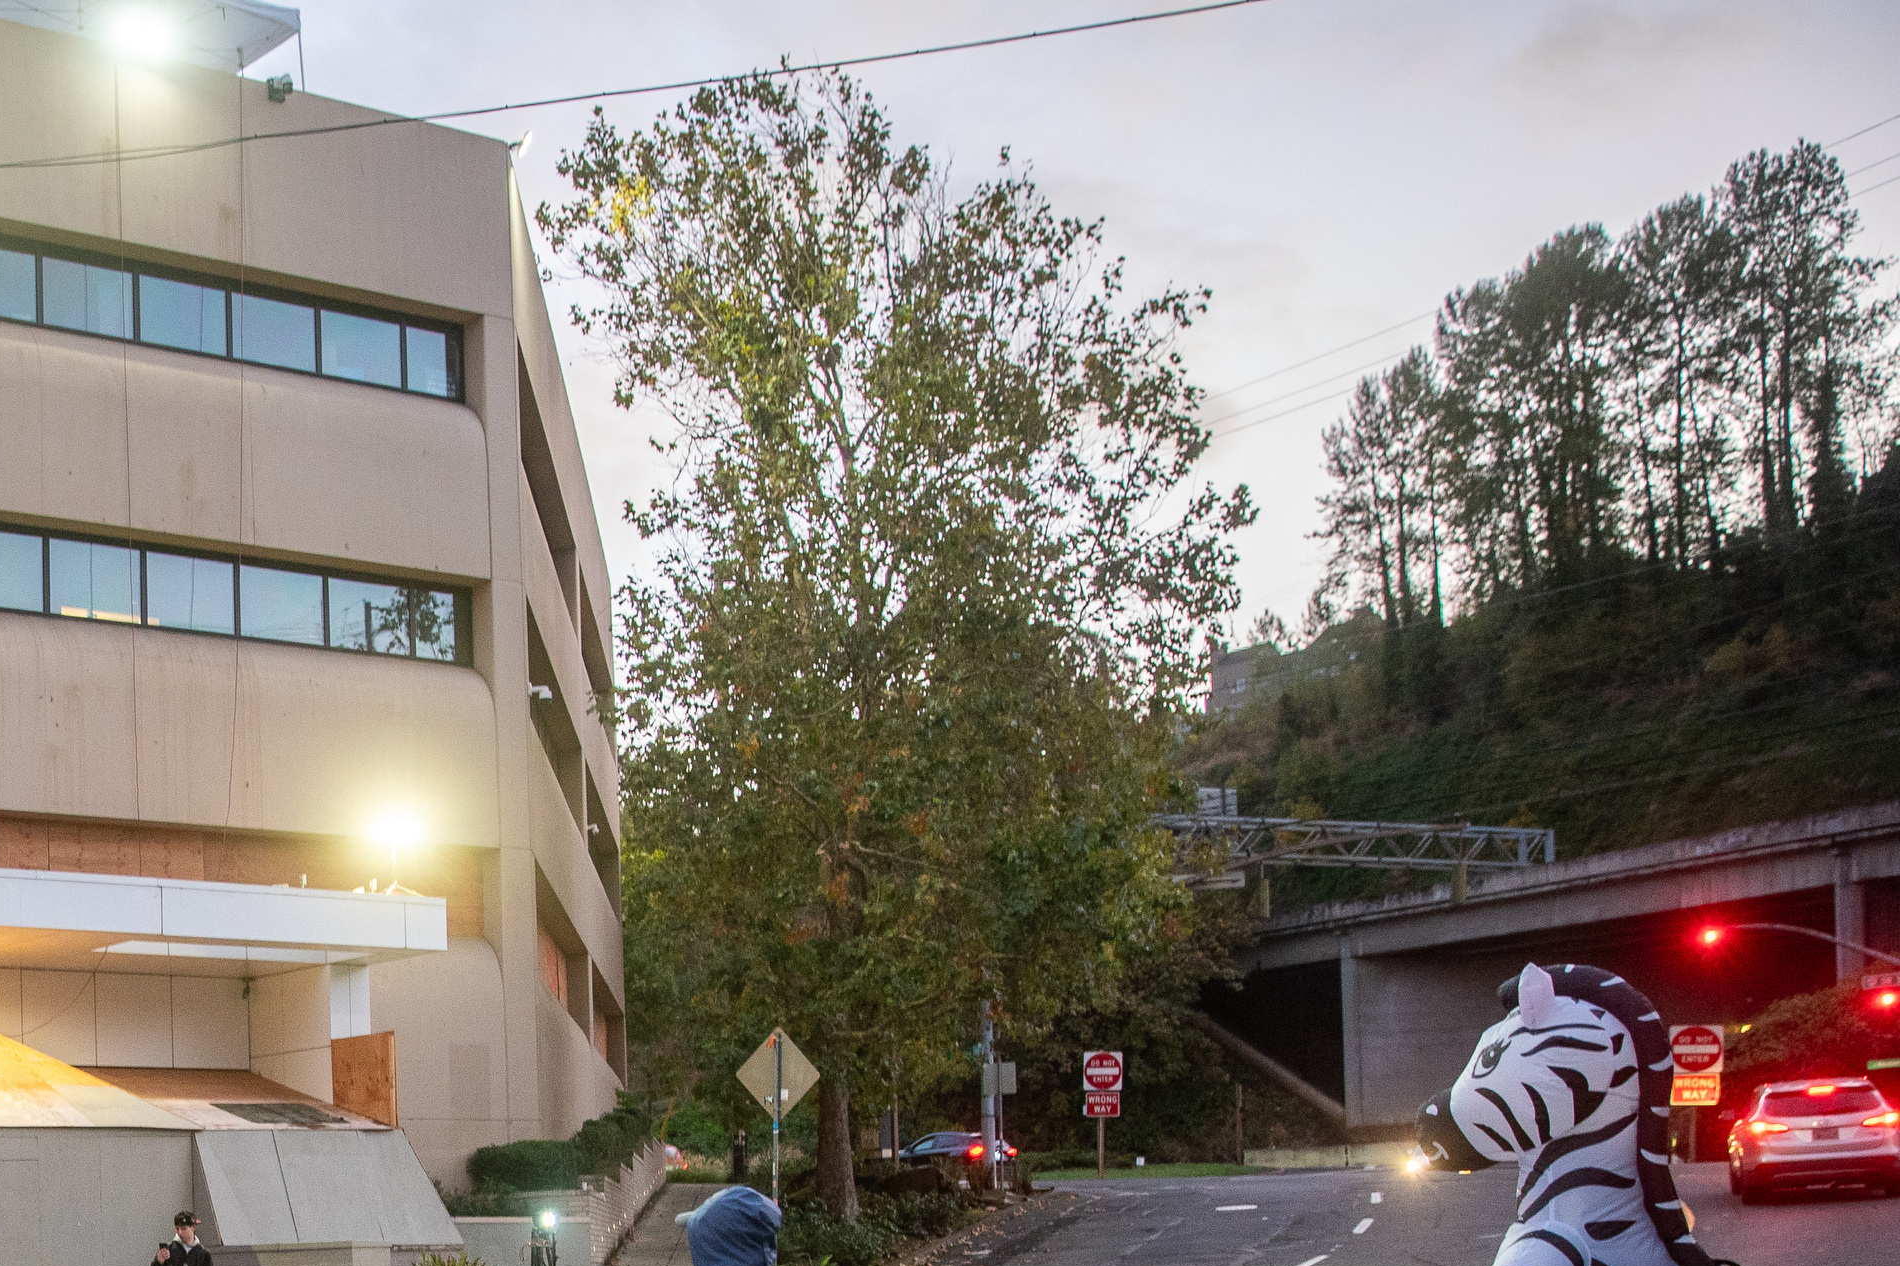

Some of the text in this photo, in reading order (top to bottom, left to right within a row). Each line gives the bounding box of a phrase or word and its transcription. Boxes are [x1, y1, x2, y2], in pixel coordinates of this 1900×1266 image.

[1090, 1059, 1115, 1067] DO NOT
[1681, 1055, 1710, 1063] ENTER
[1675, 1078, 1715, 1088] WRONG
[1682, 1089, 1708, 1099] WAY
[1088, 1096, 1117, 1104] WRONG
[1094, 1105, 1111, 1113] WAY
